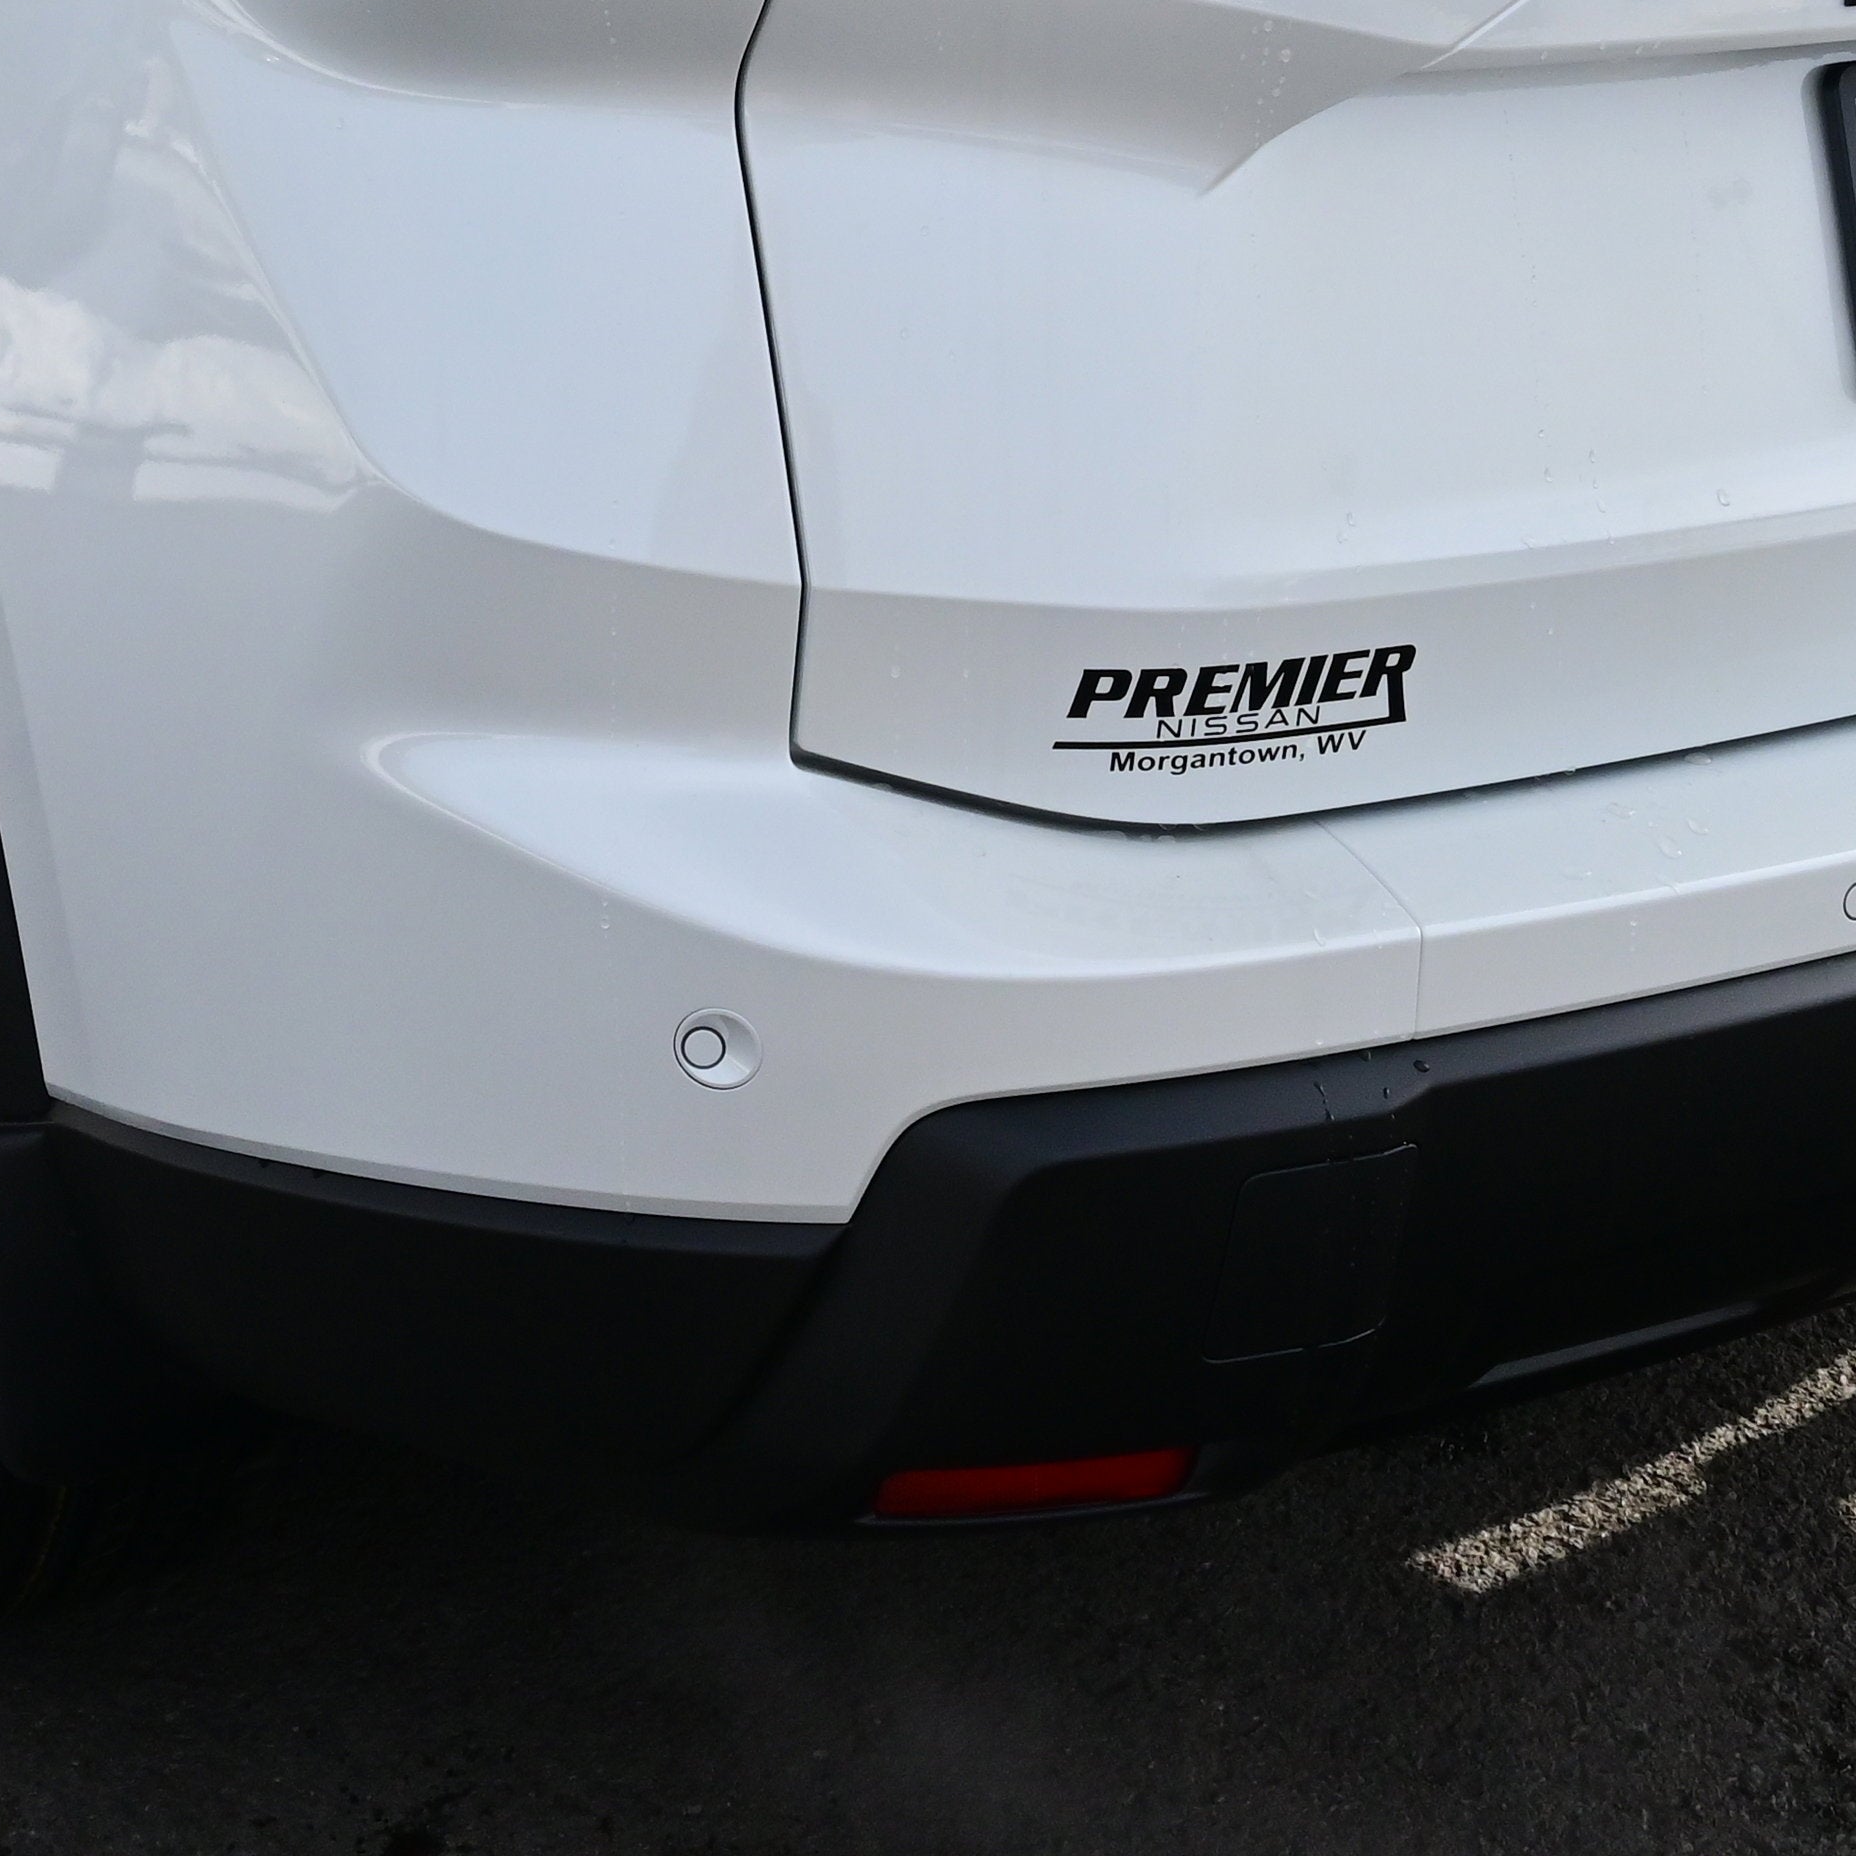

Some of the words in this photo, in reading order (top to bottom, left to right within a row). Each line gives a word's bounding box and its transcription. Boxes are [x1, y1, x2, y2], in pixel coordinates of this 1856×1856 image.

[1066, 644, 1417, 722] PREMIER
[1156, 705, 1321, 739] NISSAN
[1109, 744, 1306, 775] Morgantown,
[1317, 729, 1366, 754] WV
